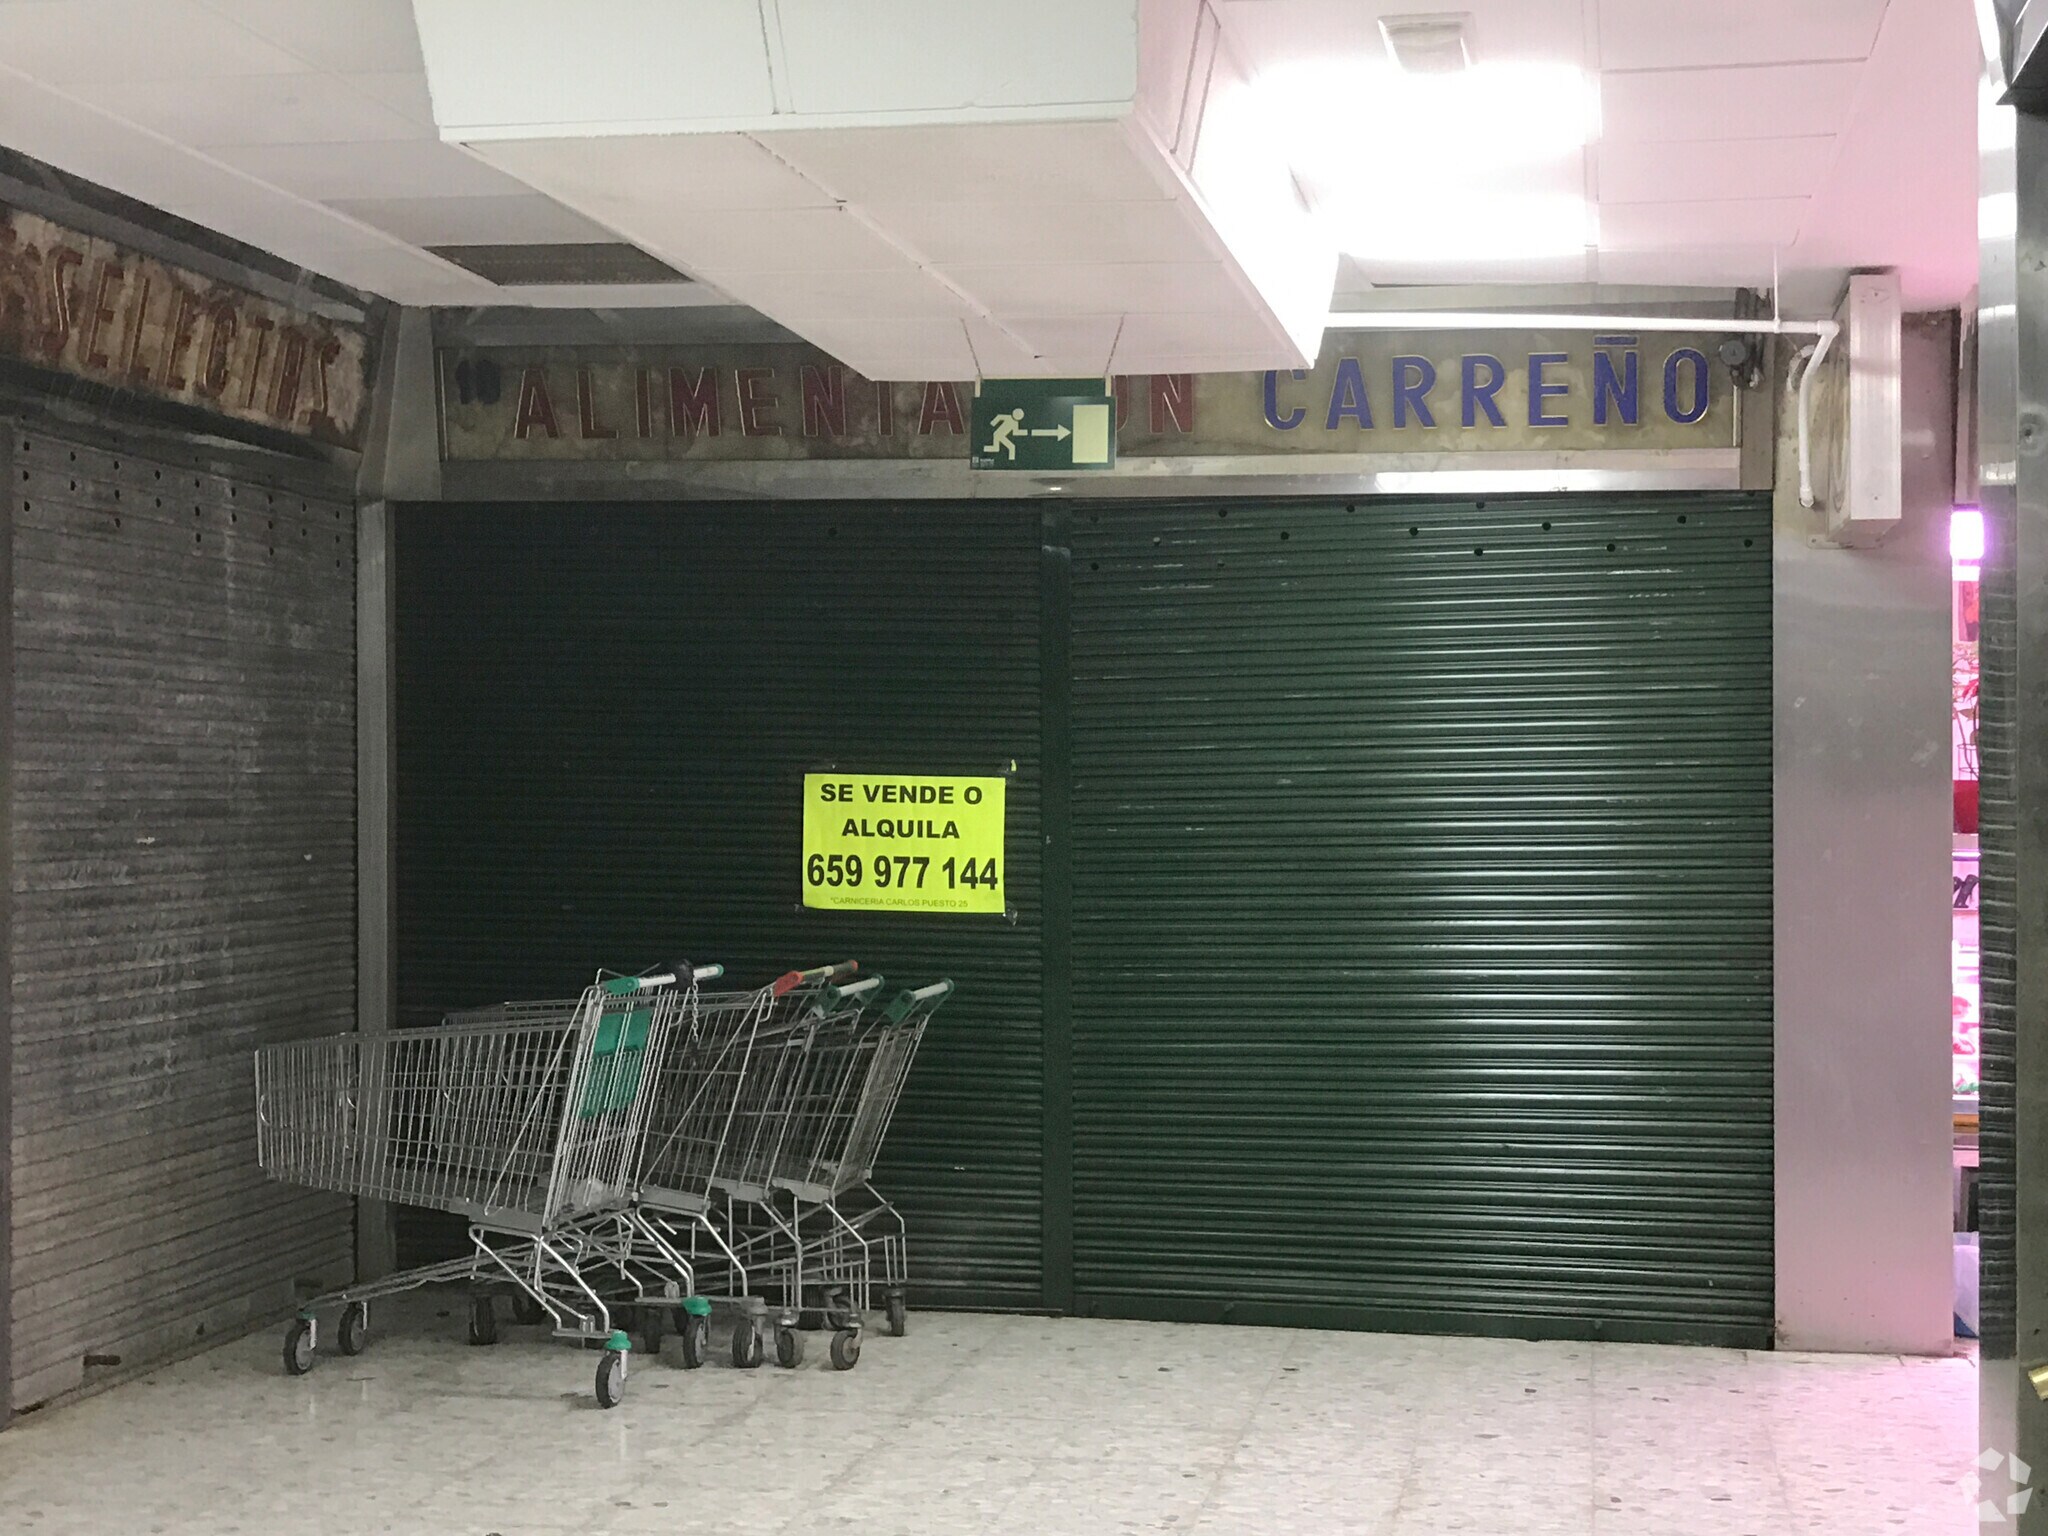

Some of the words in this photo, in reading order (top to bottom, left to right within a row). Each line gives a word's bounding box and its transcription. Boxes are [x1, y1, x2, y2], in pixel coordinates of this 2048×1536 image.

[1263, 335, 1710, 431] CARREÑO
[820, 783, 853, 803] SE
[863, 784, 954, 804] VENDE
[963, 786, 983, 805] O
[841, 818, 960, 839] ALQUILA
[807, 853, 863, 887] 659
[873, 855, 930, 889] 977
[942, 857, 998, 891] 144
[885, 898, 920, 908] CARLOS
[921, 899, 957, 908] PUESTO
[958, 900, 969, 908] 25
